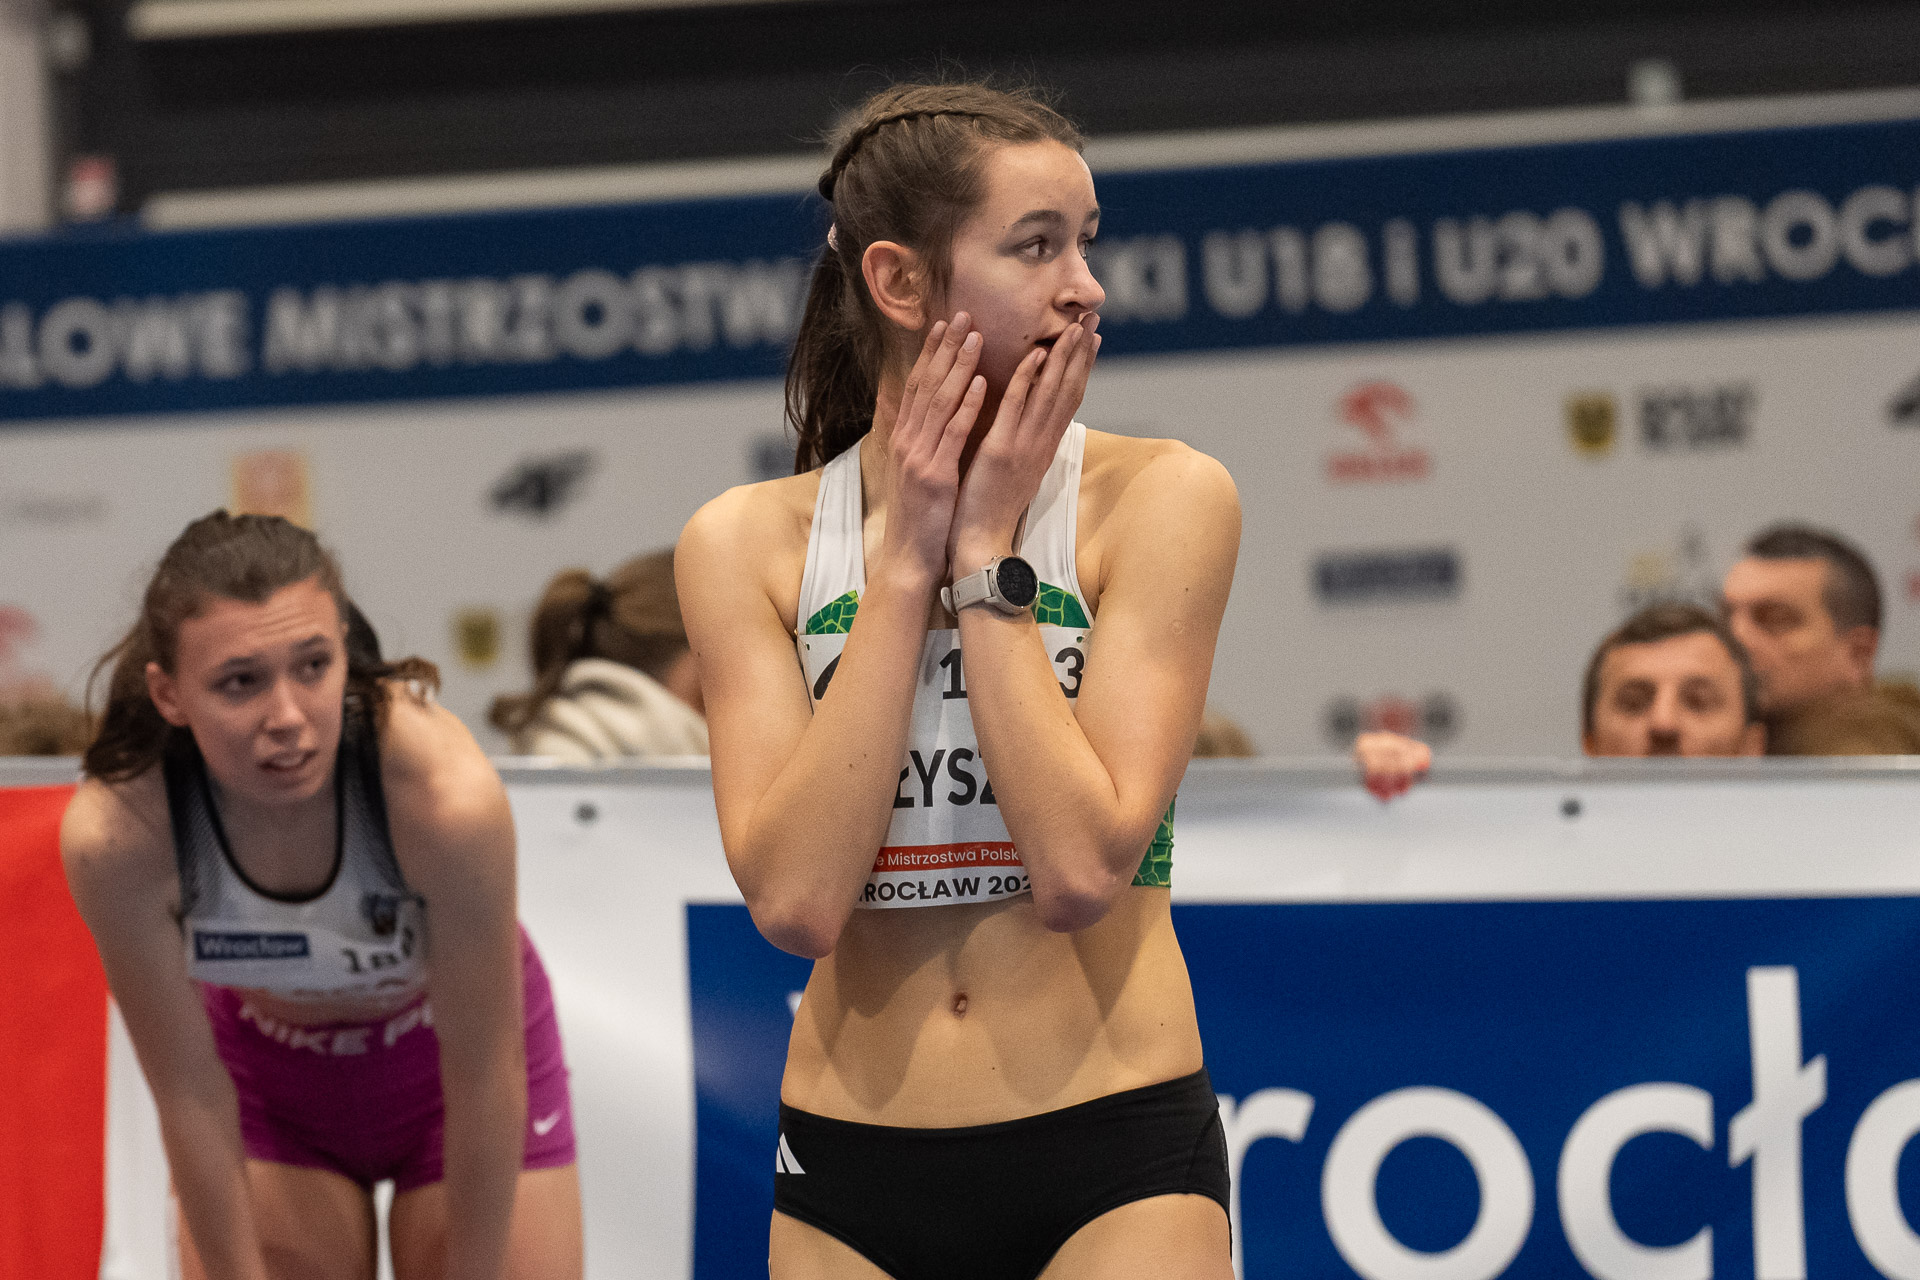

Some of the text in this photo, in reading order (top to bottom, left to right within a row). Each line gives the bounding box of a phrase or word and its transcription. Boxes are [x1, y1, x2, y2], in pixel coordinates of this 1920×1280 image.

[0, 288, 248, 389] LOWE
[266, 260, 806, 372] MISTRZOSTW
[1203, 222, 1368, 317] U18
[1434, 207, 1604, 302] U20
[1618, 186, 1920, 286] WROC
[887, 849, 977, 866] Mistrzostwa
[981, 848, 1019, 861] Polsk
[859, 875, 1031, 902] ROCŁAW 202
[239, 1002, 372, 1056] NIKE
[1213, 965, 1920, 1280] rocł
